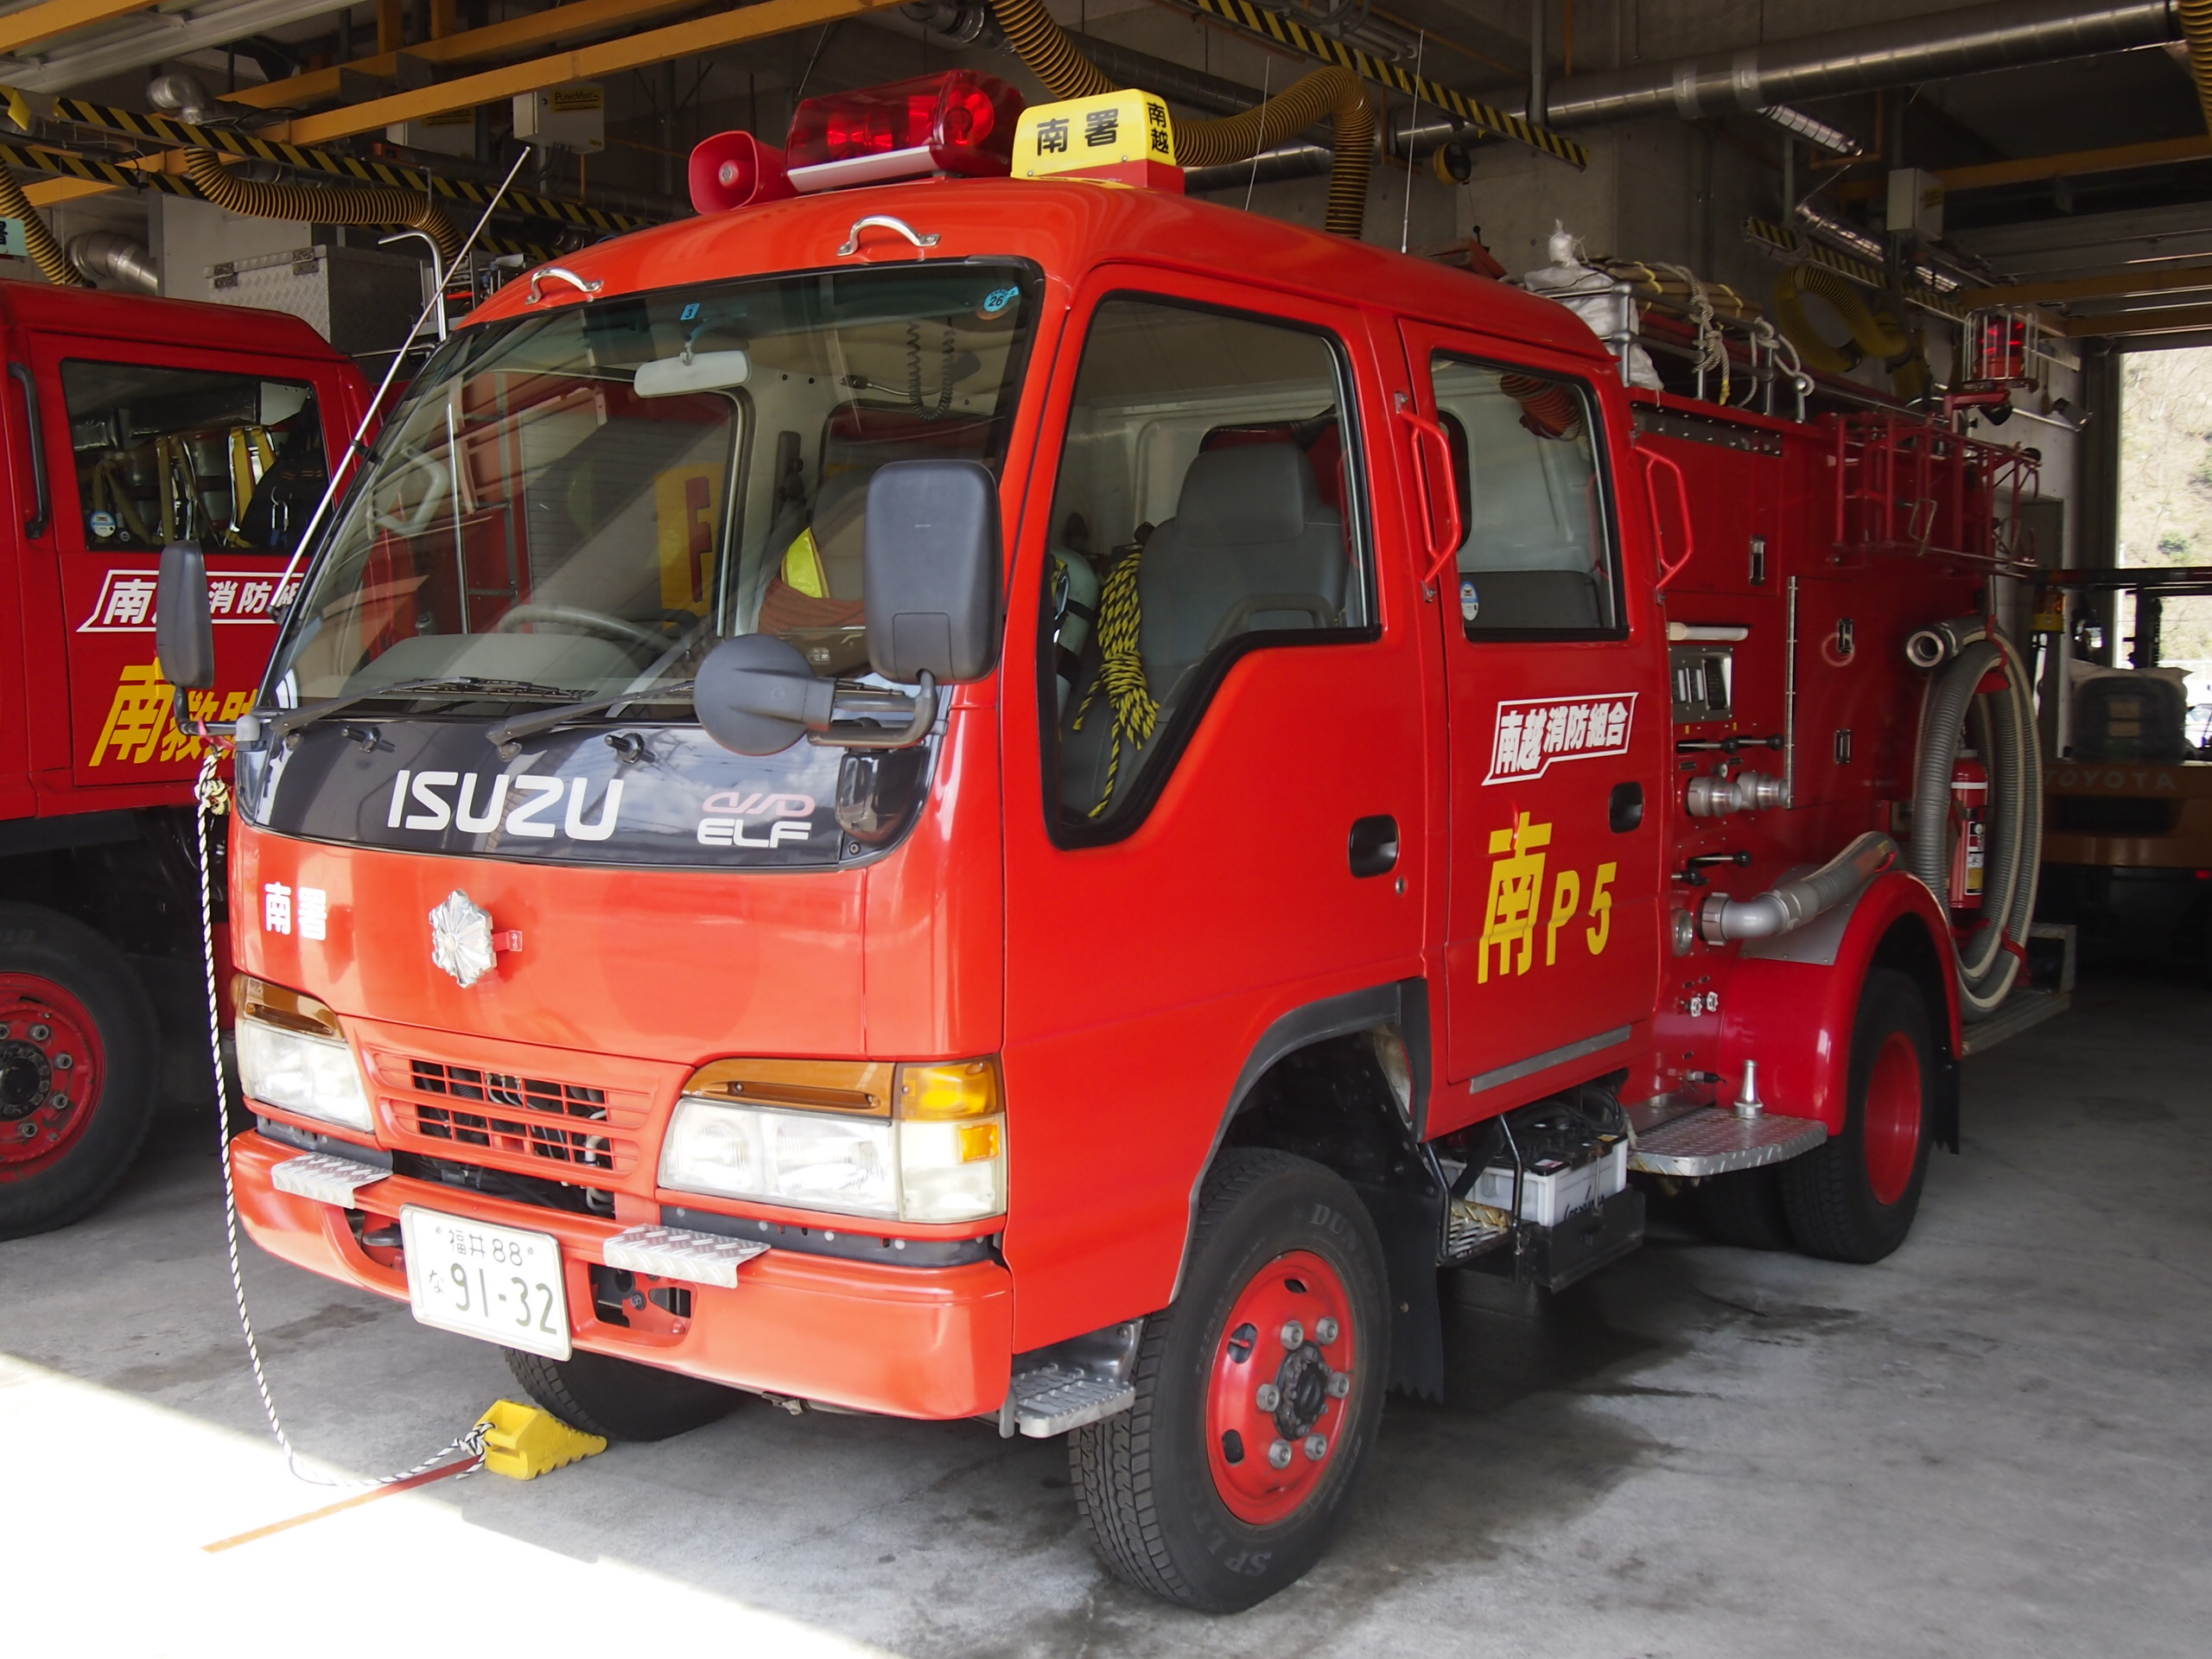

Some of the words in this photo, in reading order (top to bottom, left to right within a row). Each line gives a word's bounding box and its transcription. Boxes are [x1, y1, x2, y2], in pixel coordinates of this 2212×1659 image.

[1037, 108, 1119, 156] 南署
[1147, 102, 1169, 155] 南越
[988, 295, 1005, 308] 26
[103, 578, 301, 625] 南消防
[1495, 701, 1629, 774] 南越消防組合
[2043, 769, 2177, 791] TOYOTA
[387, 769, 625, 842] ISUZU
[696, 817, 812, 849] ELF
[264, 880, 327, 941] 南署
[450, 1262, 558, 1336] 91-32
